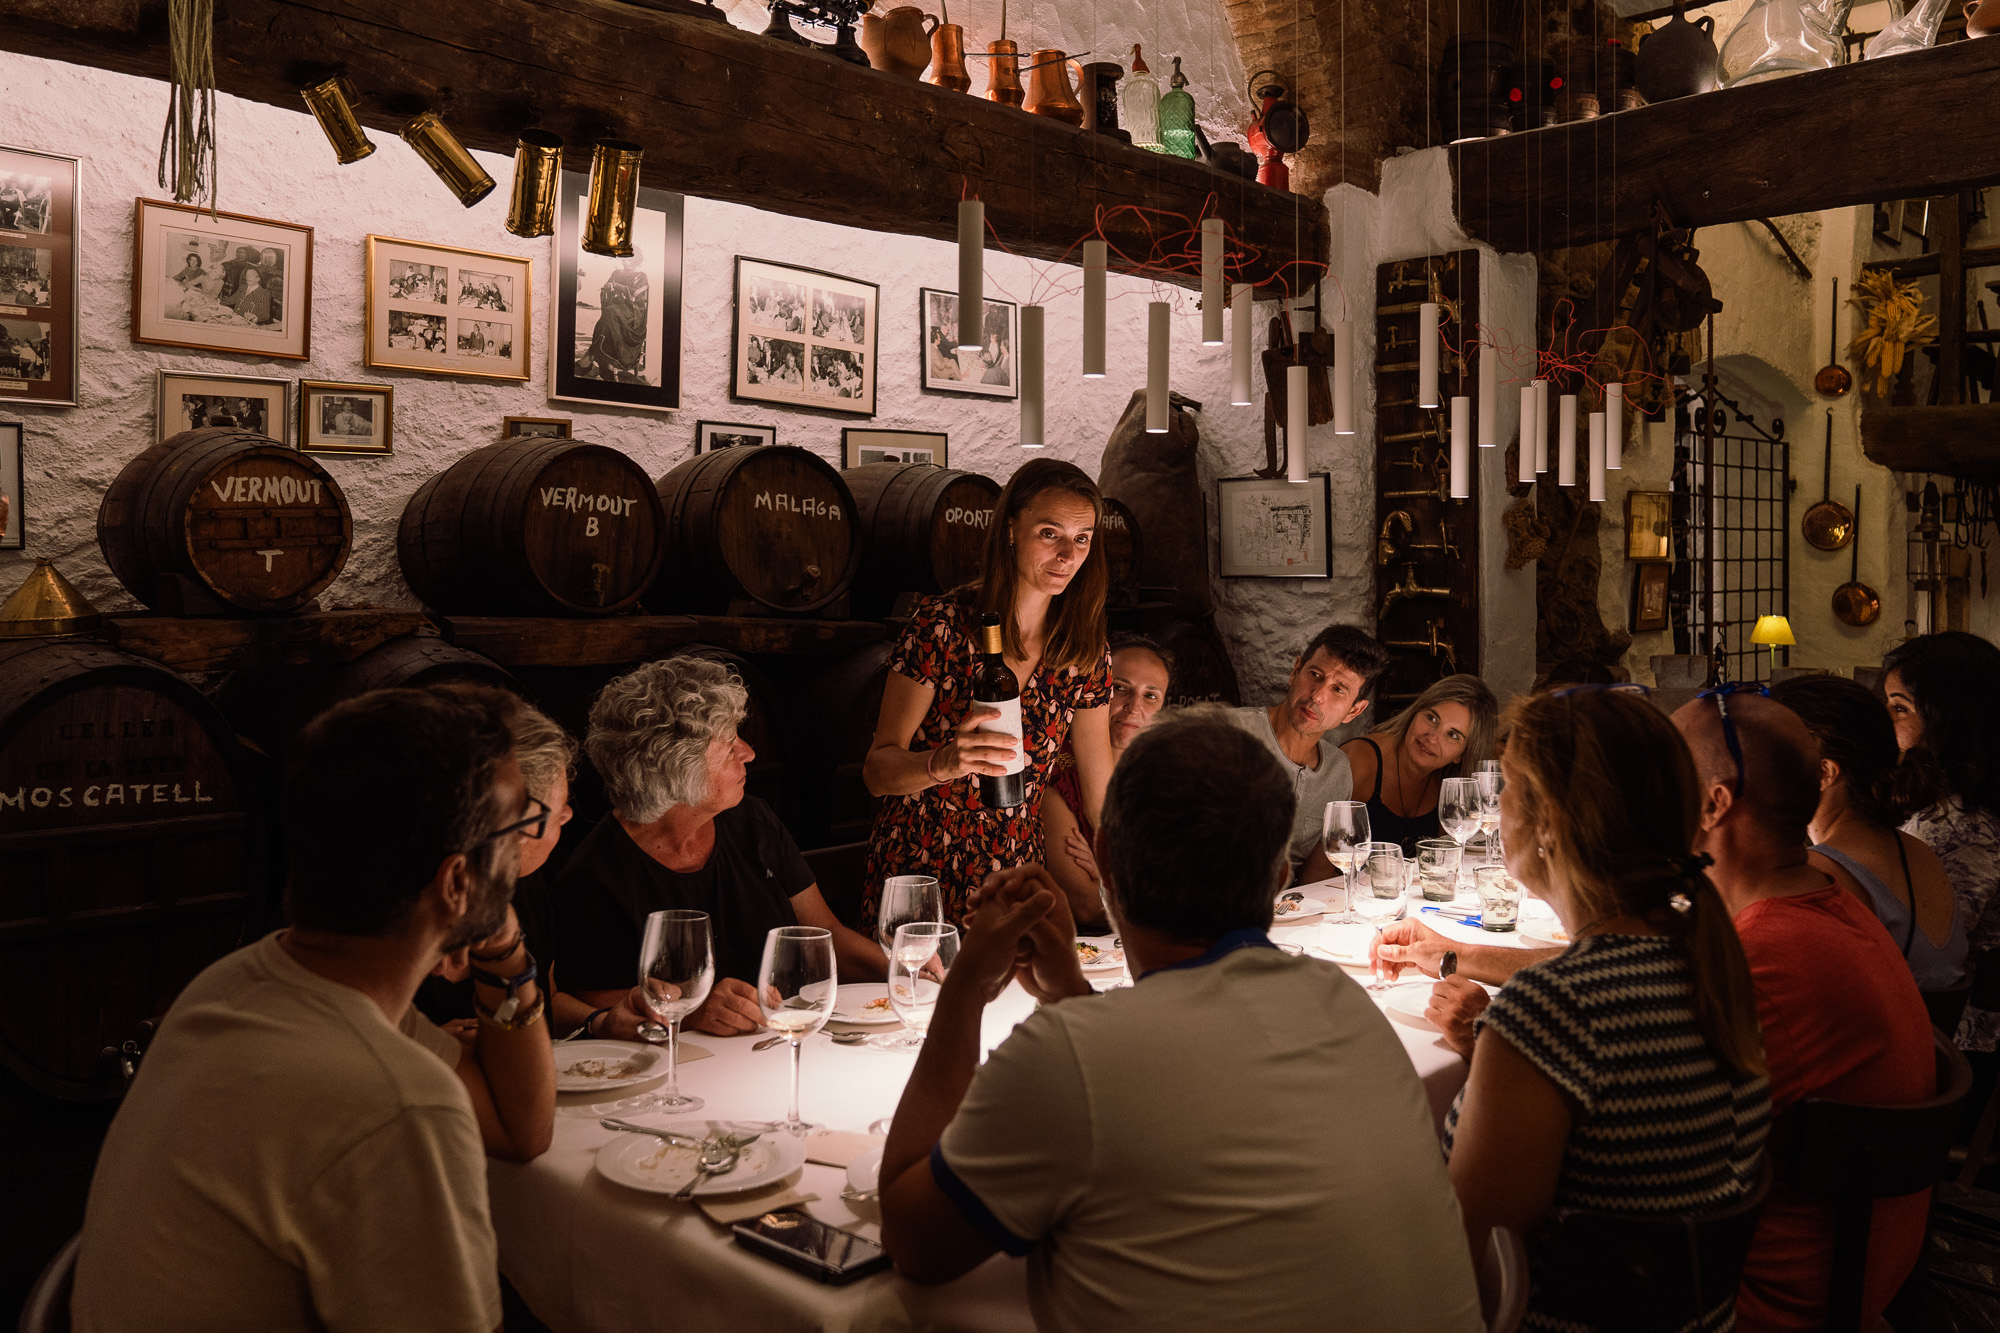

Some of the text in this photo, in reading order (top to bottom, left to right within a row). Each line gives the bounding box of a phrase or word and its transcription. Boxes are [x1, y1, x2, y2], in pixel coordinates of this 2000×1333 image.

[211, 475, 324, 506] VERMOUT
[540, 487, 638, 517] VERMOUT
[754, 490, 841, 521] MALAGA
[945, 507, 994, 530] OPORT
[585, 517, 600, 537] B
[255, 549, 285, 573] T
[60, 719, 175, 740] CELLER
[0, 781, 213, 811] MOSCATELL
